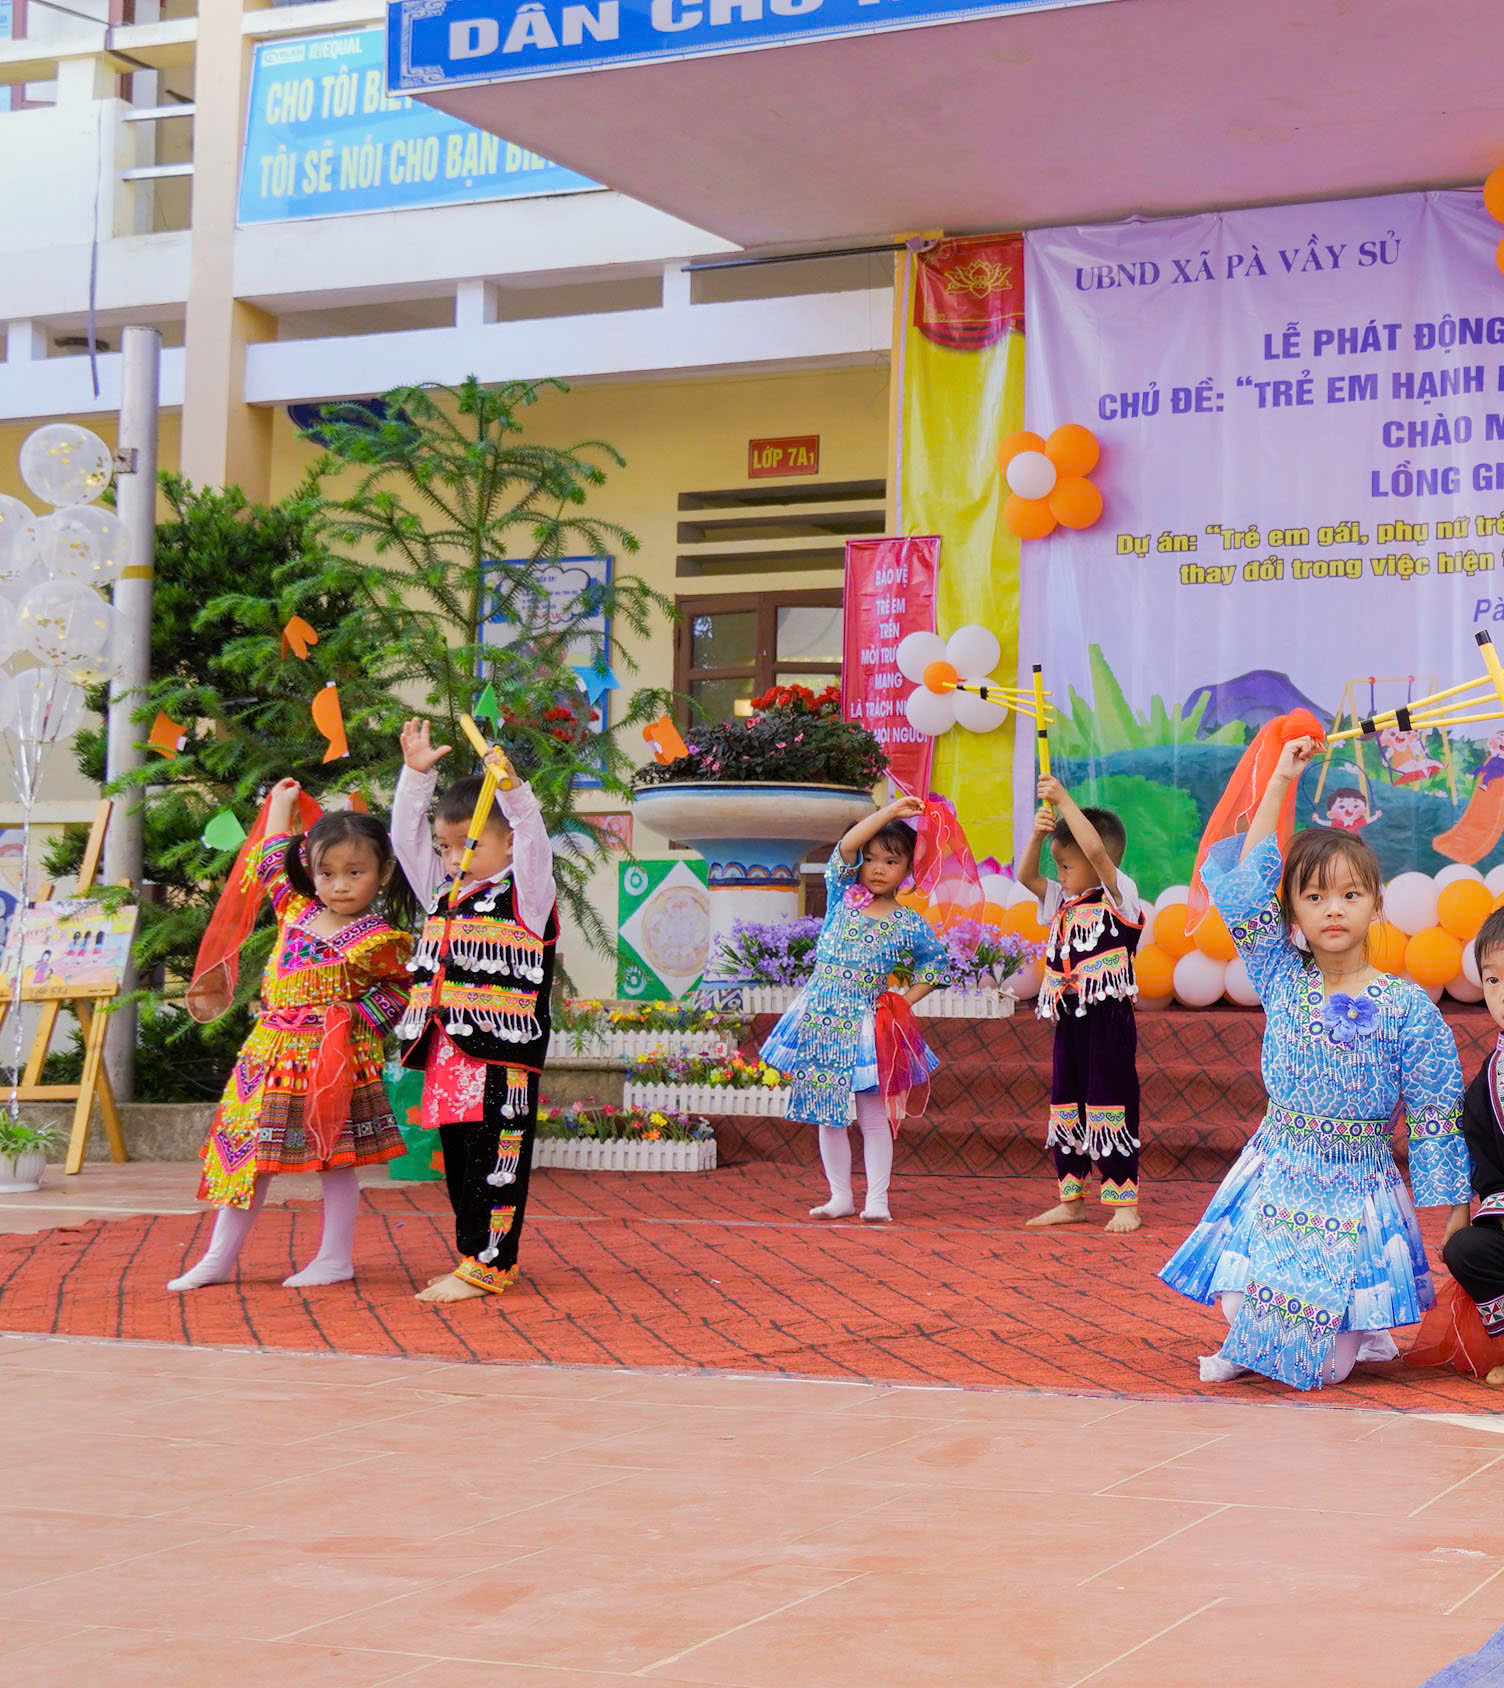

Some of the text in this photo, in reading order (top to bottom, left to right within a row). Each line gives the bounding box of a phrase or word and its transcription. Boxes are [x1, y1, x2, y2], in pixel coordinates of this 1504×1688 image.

[449, 3, 620, 60] DÂN
[266, 77, 314, 125] CHO
[321, 63, 358, 119] TÔI
[260, 145, 297, 198] TÔI
[303, 140, 333, 194] SẼ
[340, 134, 382, 191] NÓI
[389, 136, 439, 185] CHO
[446, 131, 498, 188] BẠN
[1075, 230, 1400, 291] UBND XÃ PÀ VẦY SỦ
[1263, 320, 1301, 361] LỄ
[1313, 319, 1402, 357] PHÁT
[1097, 381, 1160, 421] CHỦ
[1170, 376, 1225, 415] ĐỀ:
[1236, 370, 1314, 409] “TRẺ
[1327, 373, 1378, 405] EM
[1392, 365, 1485, 406] HẠNH
[1381, 412, 1473, 450] CHÀO
[753, 446, 783, 470] LỚP
[1371, 460, 1461, 498] LỒNG
[1116, 533, 1150, 559] Dự
[1156, 530, 1198, 553] án:
[1205, 524, 1260, 551] “Trẻ
[1267, 526, 1310, 547] em
[1317, 519, 1370, 547] gái,
[1376, 520, 1430, 547] phụ
[1435, 515, 1471, 540] nữ
[875, 563, 908, 589] BẢO VỆ
[1180, 563, 1237, 586] thay
[1242, 555, 1285, 582] đổi
[1291, 556, 1363, 579] trong
[1370, 552, 1430, 580] việc
[1437, 550, 1495, 576] hiện
[876, 592, 906, 615] TRẺ EM
[880, 618, 900, 639] TRÊN
[874, 672, 903, 694] MẠNG
[850, 698, 863, 718] LÀ
[865, 696, 893, 718] TRÁCH
